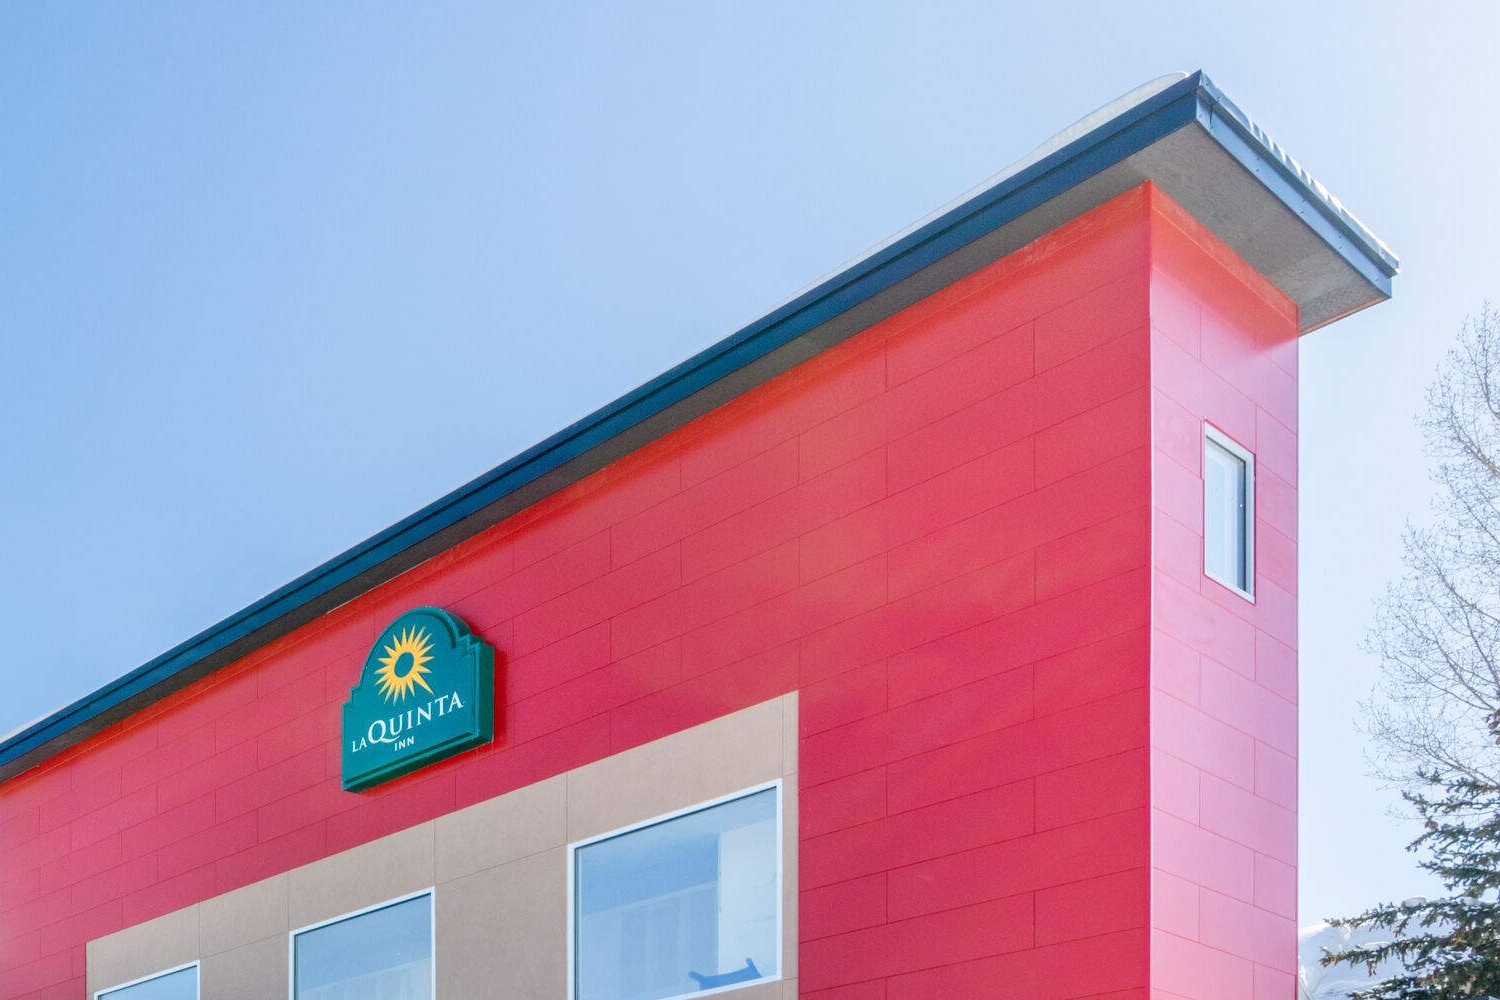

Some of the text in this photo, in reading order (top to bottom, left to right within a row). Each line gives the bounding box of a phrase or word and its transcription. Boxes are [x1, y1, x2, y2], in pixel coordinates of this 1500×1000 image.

[352, 690, 464, 752] LA QUINTA
[394, 735, 414, 751] INN
